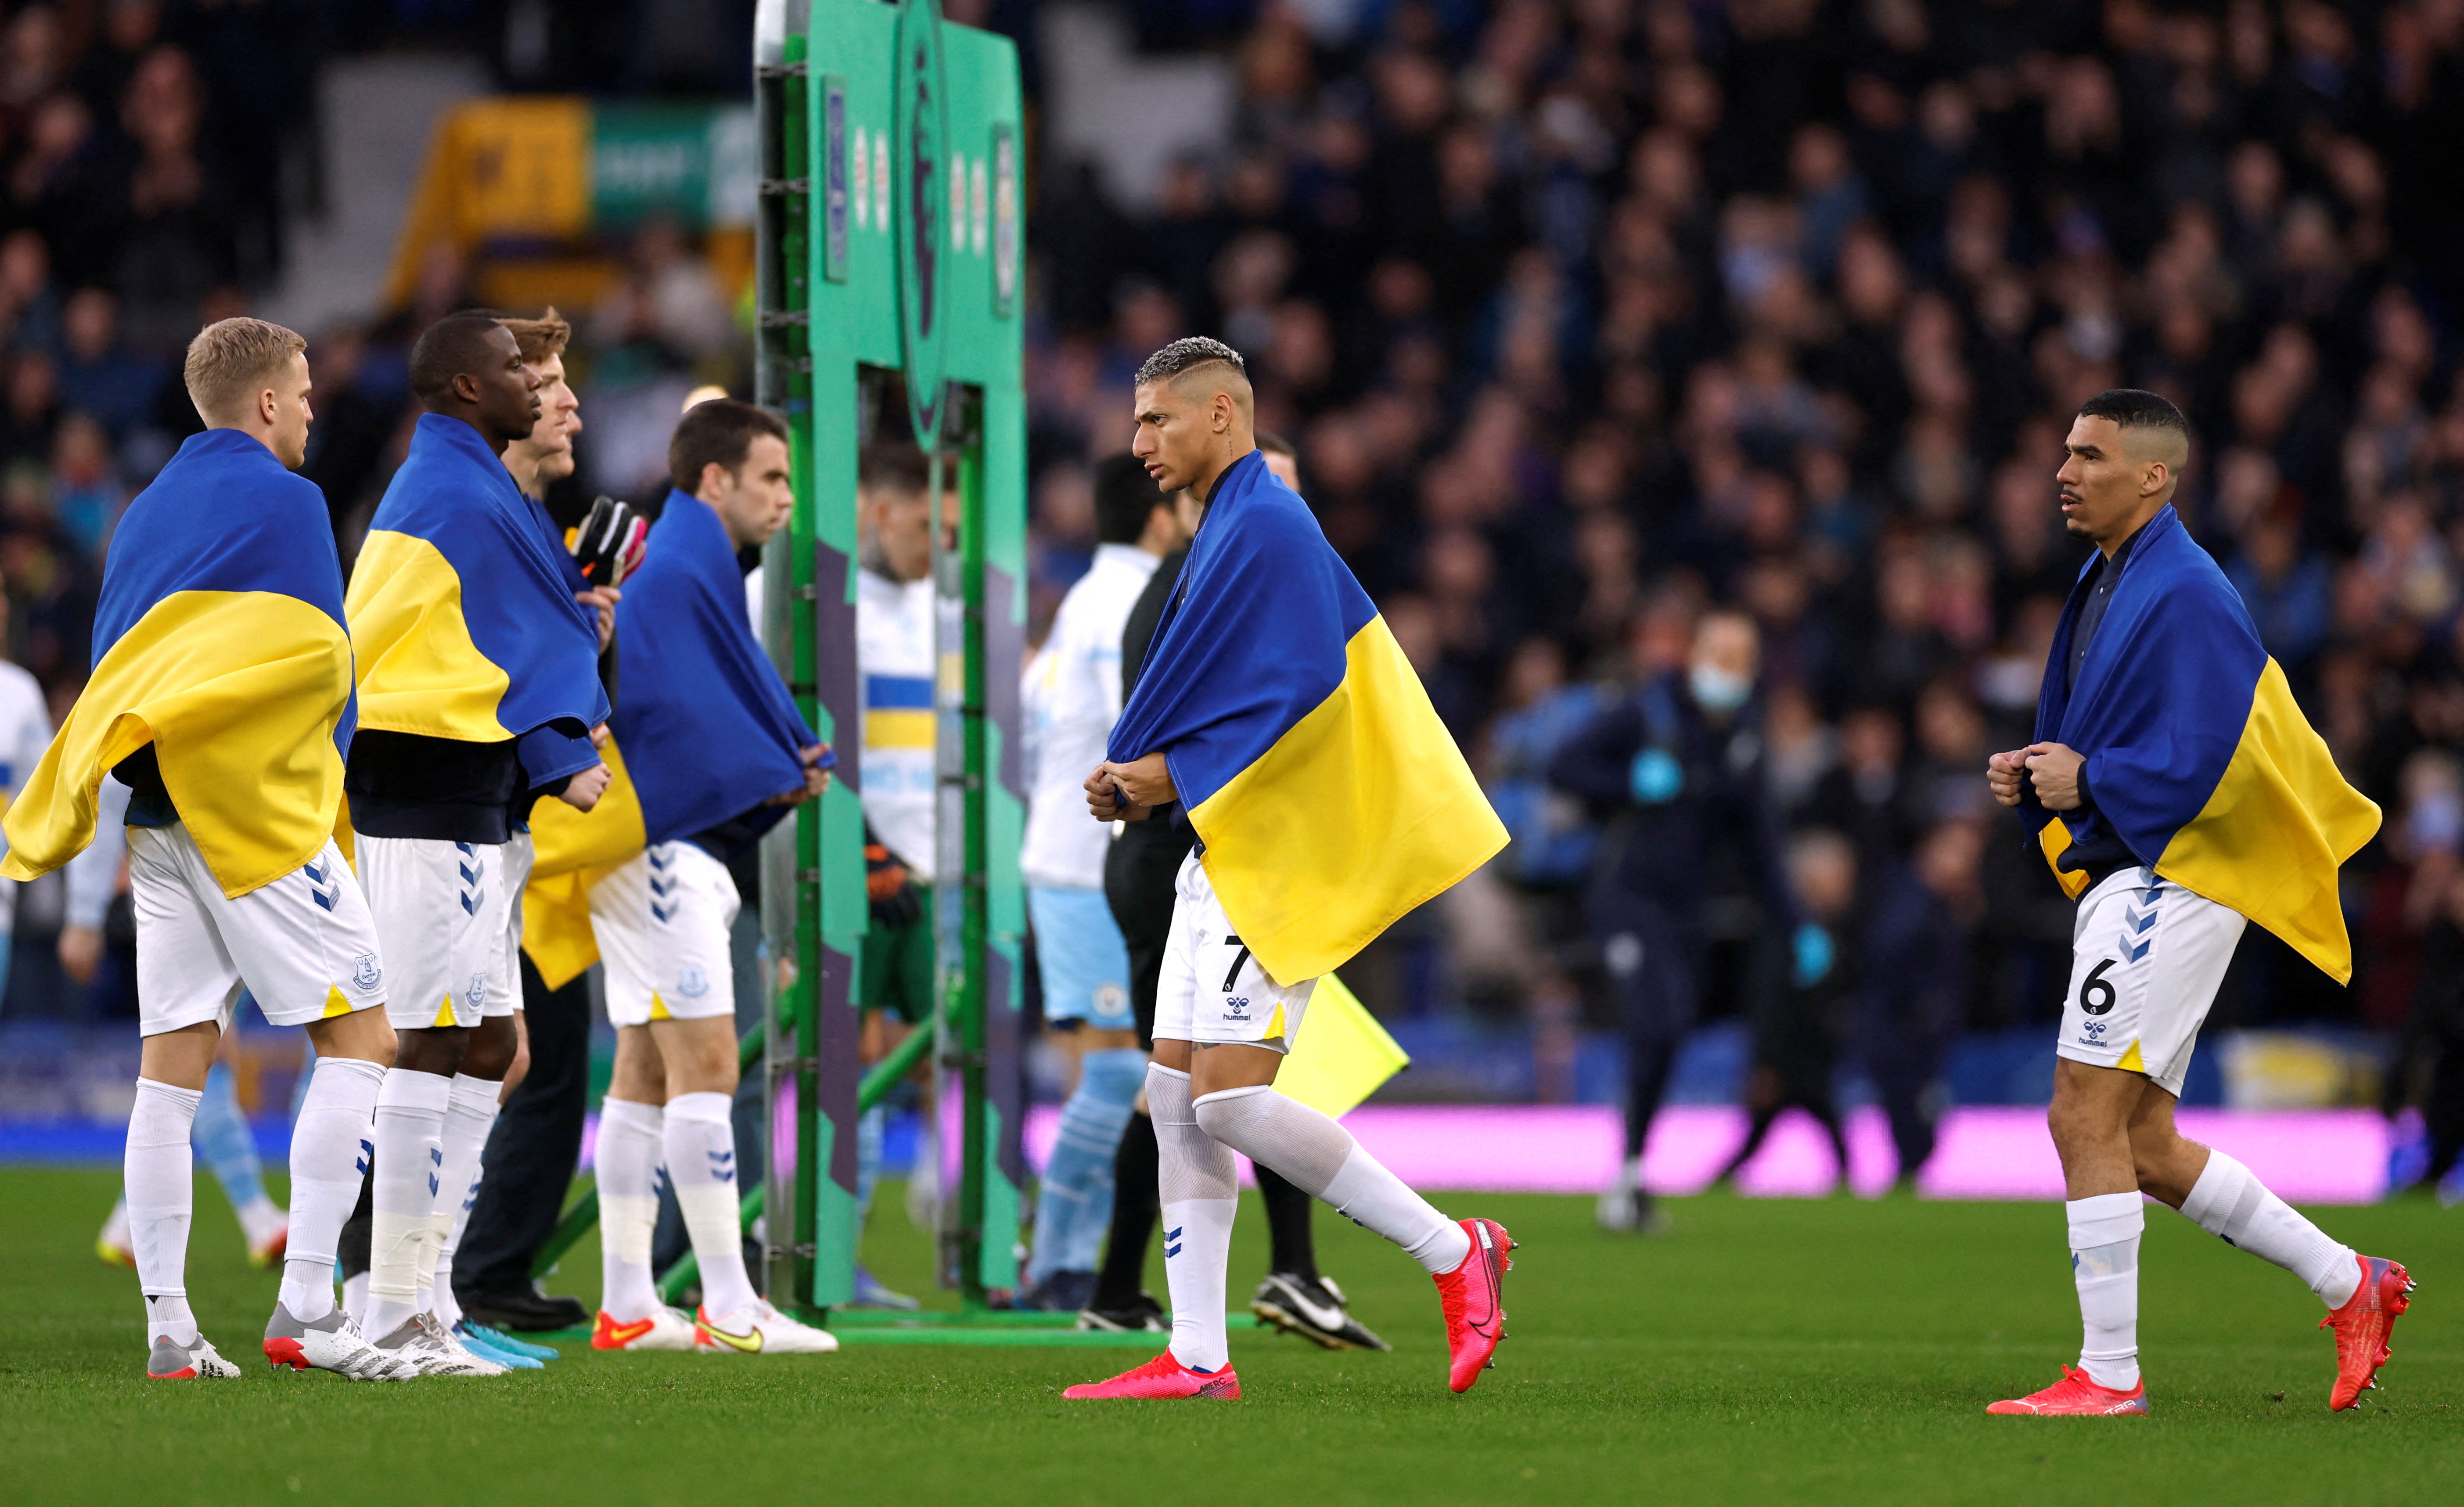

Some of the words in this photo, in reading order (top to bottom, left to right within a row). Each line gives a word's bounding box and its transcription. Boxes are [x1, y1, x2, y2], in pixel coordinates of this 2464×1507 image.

[1222, 935, 1251, 992] 7
[2080, 958, 2118, 1015] 6
[2079, 1036, 2107, 1047] hummel
